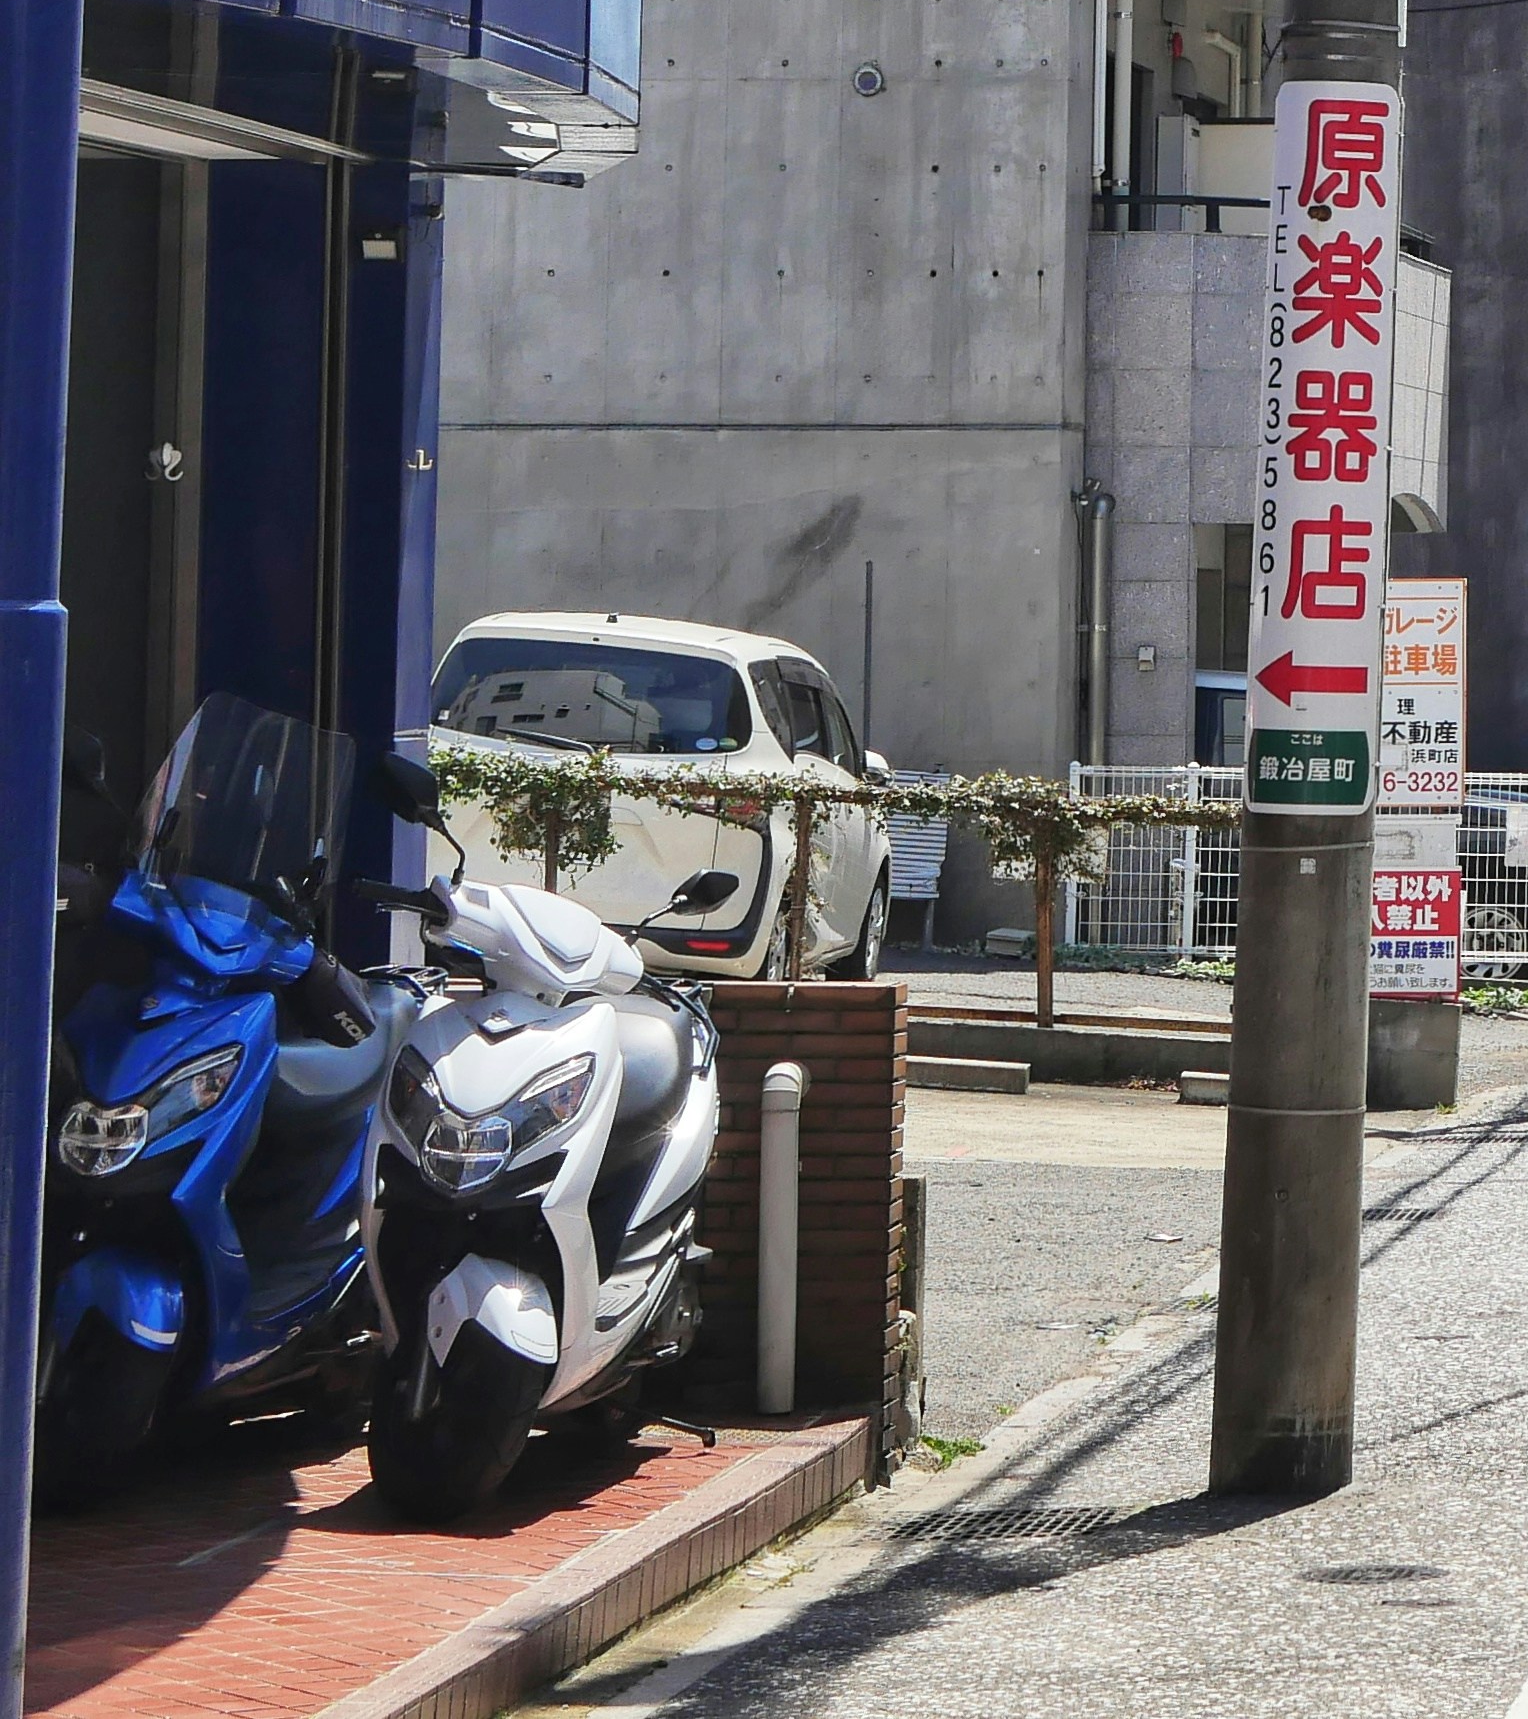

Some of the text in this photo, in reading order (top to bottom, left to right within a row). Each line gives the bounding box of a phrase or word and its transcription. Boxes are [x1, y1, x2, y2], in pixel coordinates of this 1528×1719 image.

[1280, 98, 1390, 620] 原楽器店
[1290, 734, 1324, 745] ここは
[1382, 721, 1459, 745] 不動産
[1411, 748, 1460, 764] 浜町店
[1259, 756, 1356, 782] 鍛冶屋町
[1383, 771, 1459, 792] 6-3232
